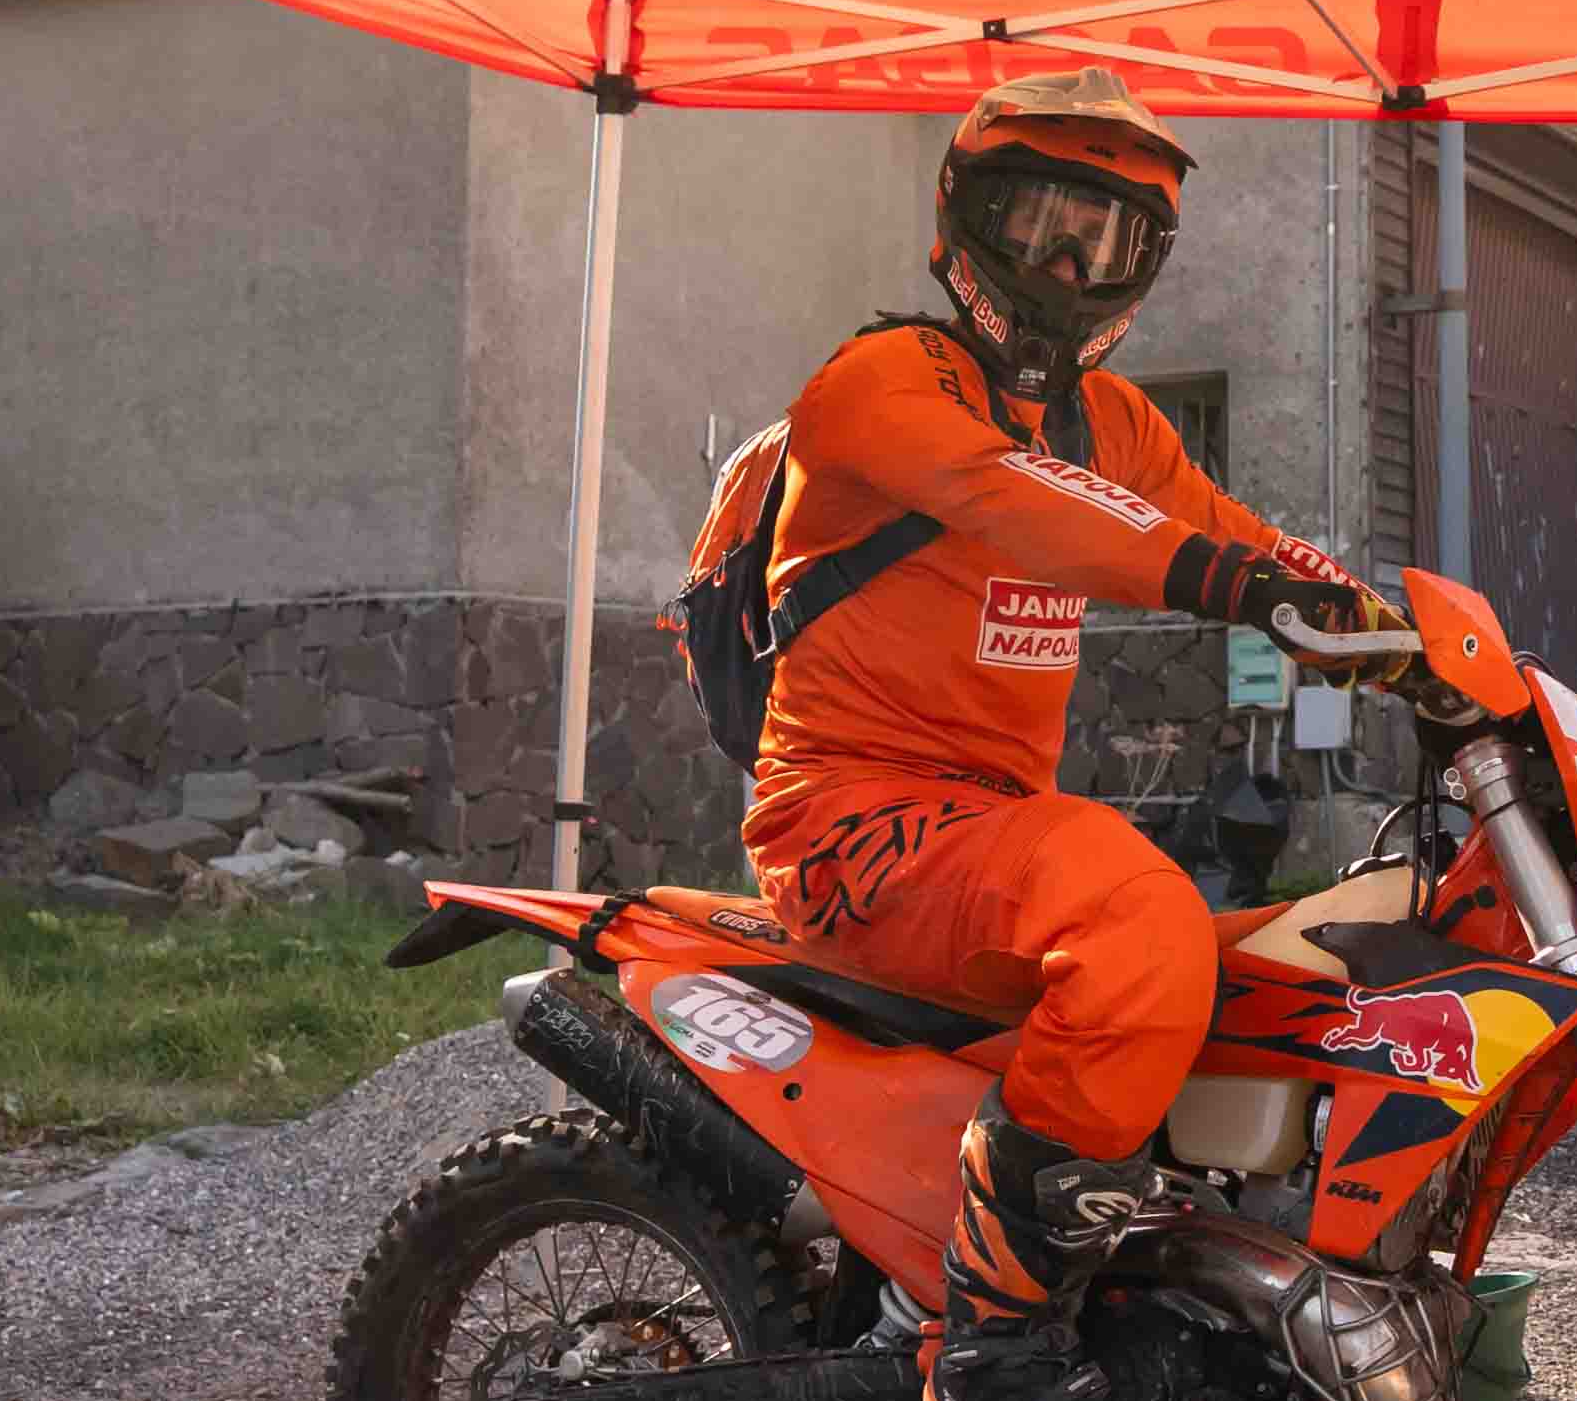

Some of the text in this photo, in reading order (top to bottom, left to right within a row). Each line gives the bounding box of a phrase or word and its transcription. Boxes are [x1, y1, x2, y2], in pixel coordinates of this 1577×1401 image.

[947, 256, 1008, 344] Red Bull
[988, 631, 1079, 658] NÁPOJ
[667, 985, 808, 1059] 165
[1326, 1180, 1383, 1204] KTM
